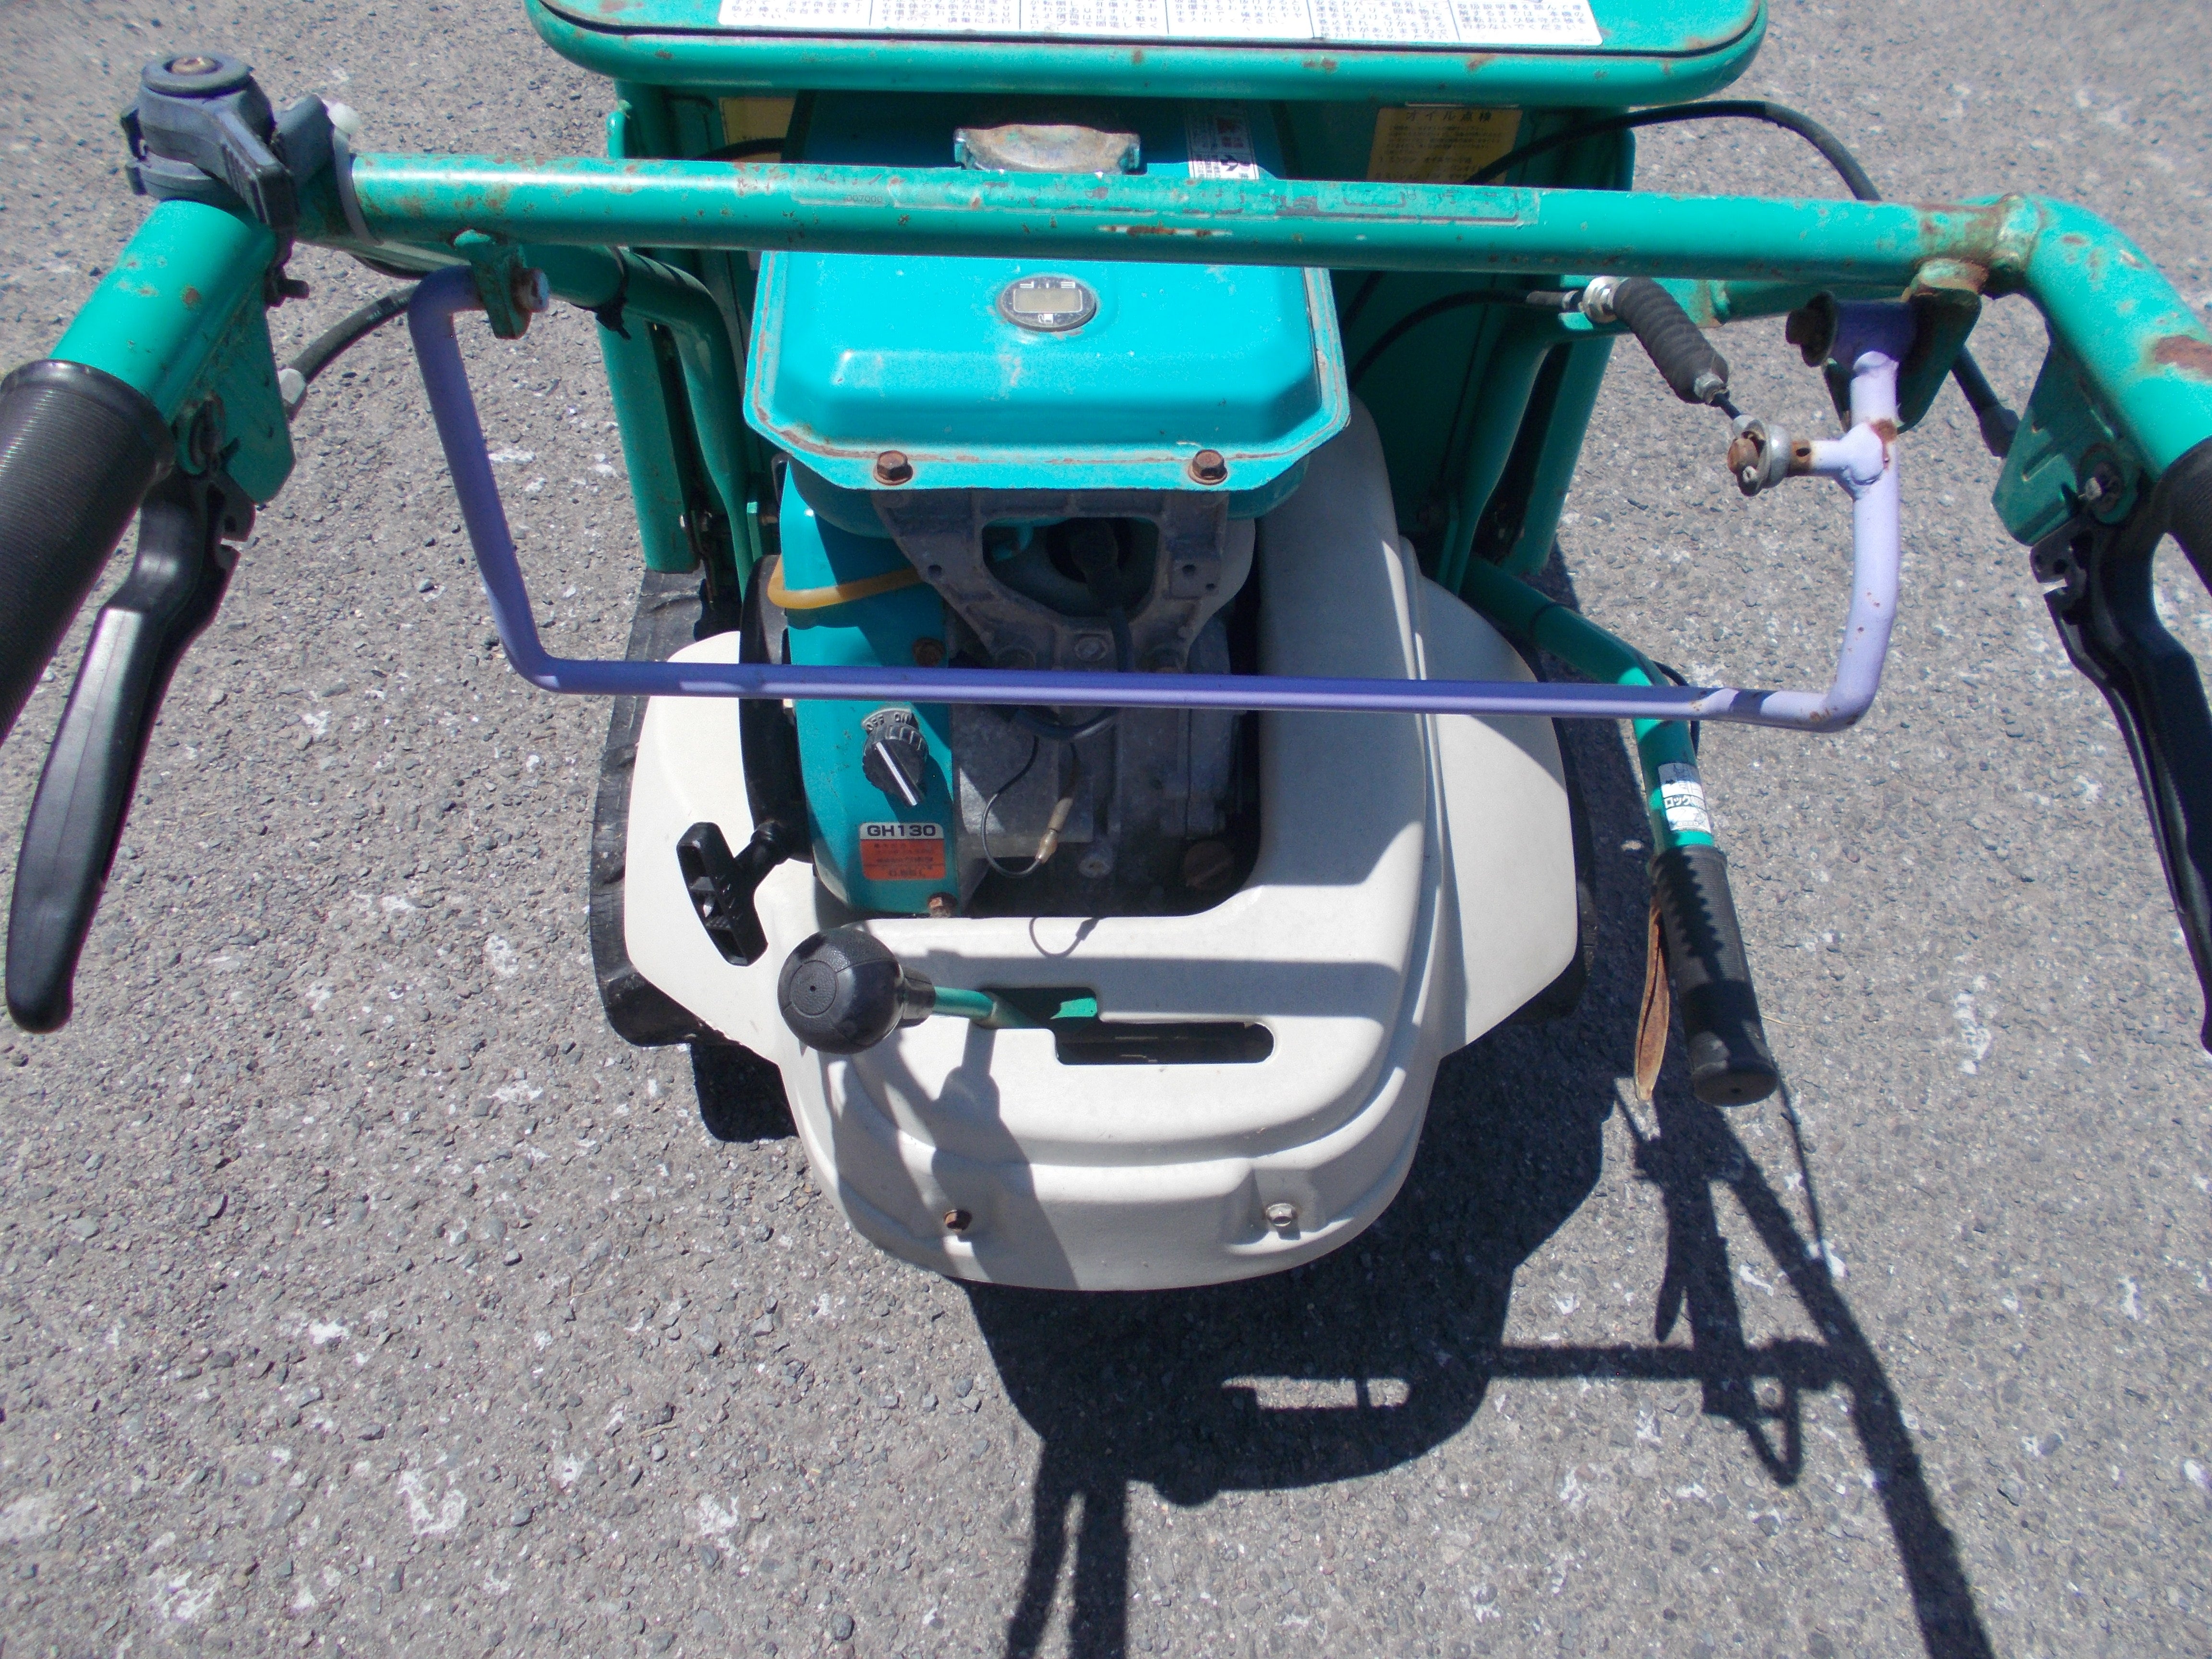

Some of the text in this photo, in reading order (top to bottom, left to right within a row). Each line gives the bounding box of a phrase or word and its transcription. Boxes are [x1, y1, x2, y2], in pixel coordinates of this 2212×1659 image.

[1407, 110, 1492, 122] オイル点検
[866, 713, 912, 732] OFF ON
[1664, 794, 1691, 808] ロック
[867, 825, 936, 836] GH130
